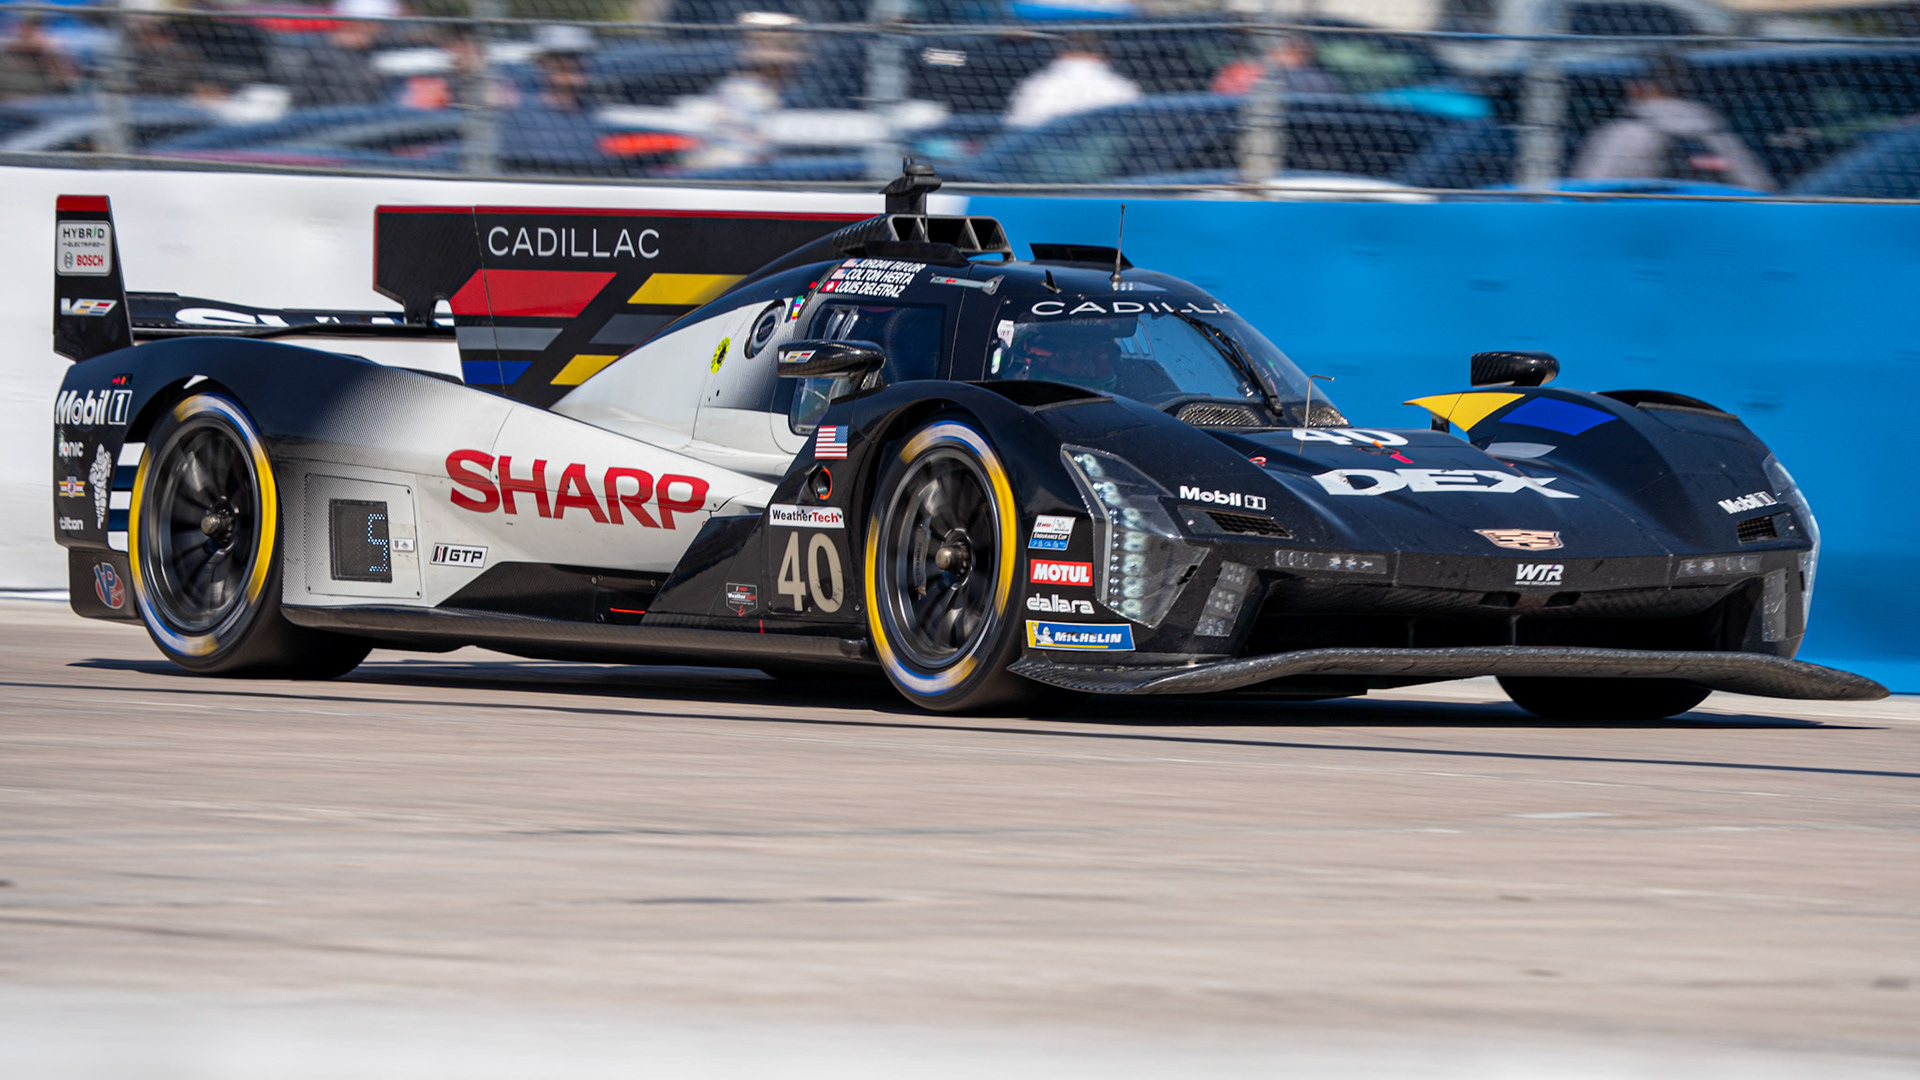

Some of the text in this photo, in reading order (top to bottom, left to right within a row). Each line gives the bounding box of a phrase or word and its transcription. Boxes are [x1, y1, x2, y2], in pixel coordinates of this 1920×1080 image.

[63, 225, 105, 239] HYBRID
[488, 226, 660, 259] CADILLAC
[76, 254, 104, 267] BOSCH
[845, 269, 916, 285] COLTON HERTA
[834, 281, 906, 298] LOUIS DELETRAZ
[55, 390, 111, 425] Mobil
[1292, 428, 1408, 445] 40
[445, 449, 710, 530] SHARP
[1312, 468, 1580, 499] DEX
[1179, 485, 1242, 506] Mobil
[1717, 493, 1765, 515] Mobil
[771, 508, 843, 524] WeatherTech
[449, 549, 483, 563] GTP
[777, 530, 844, 614] 40
[1033, 563, 1090, 583] MOTUL
[1516, 564, 1564, 581] WTR
[1026, 592, 1095, 614] dallara
[1054, 631, 1122, 644] MICHELIN
